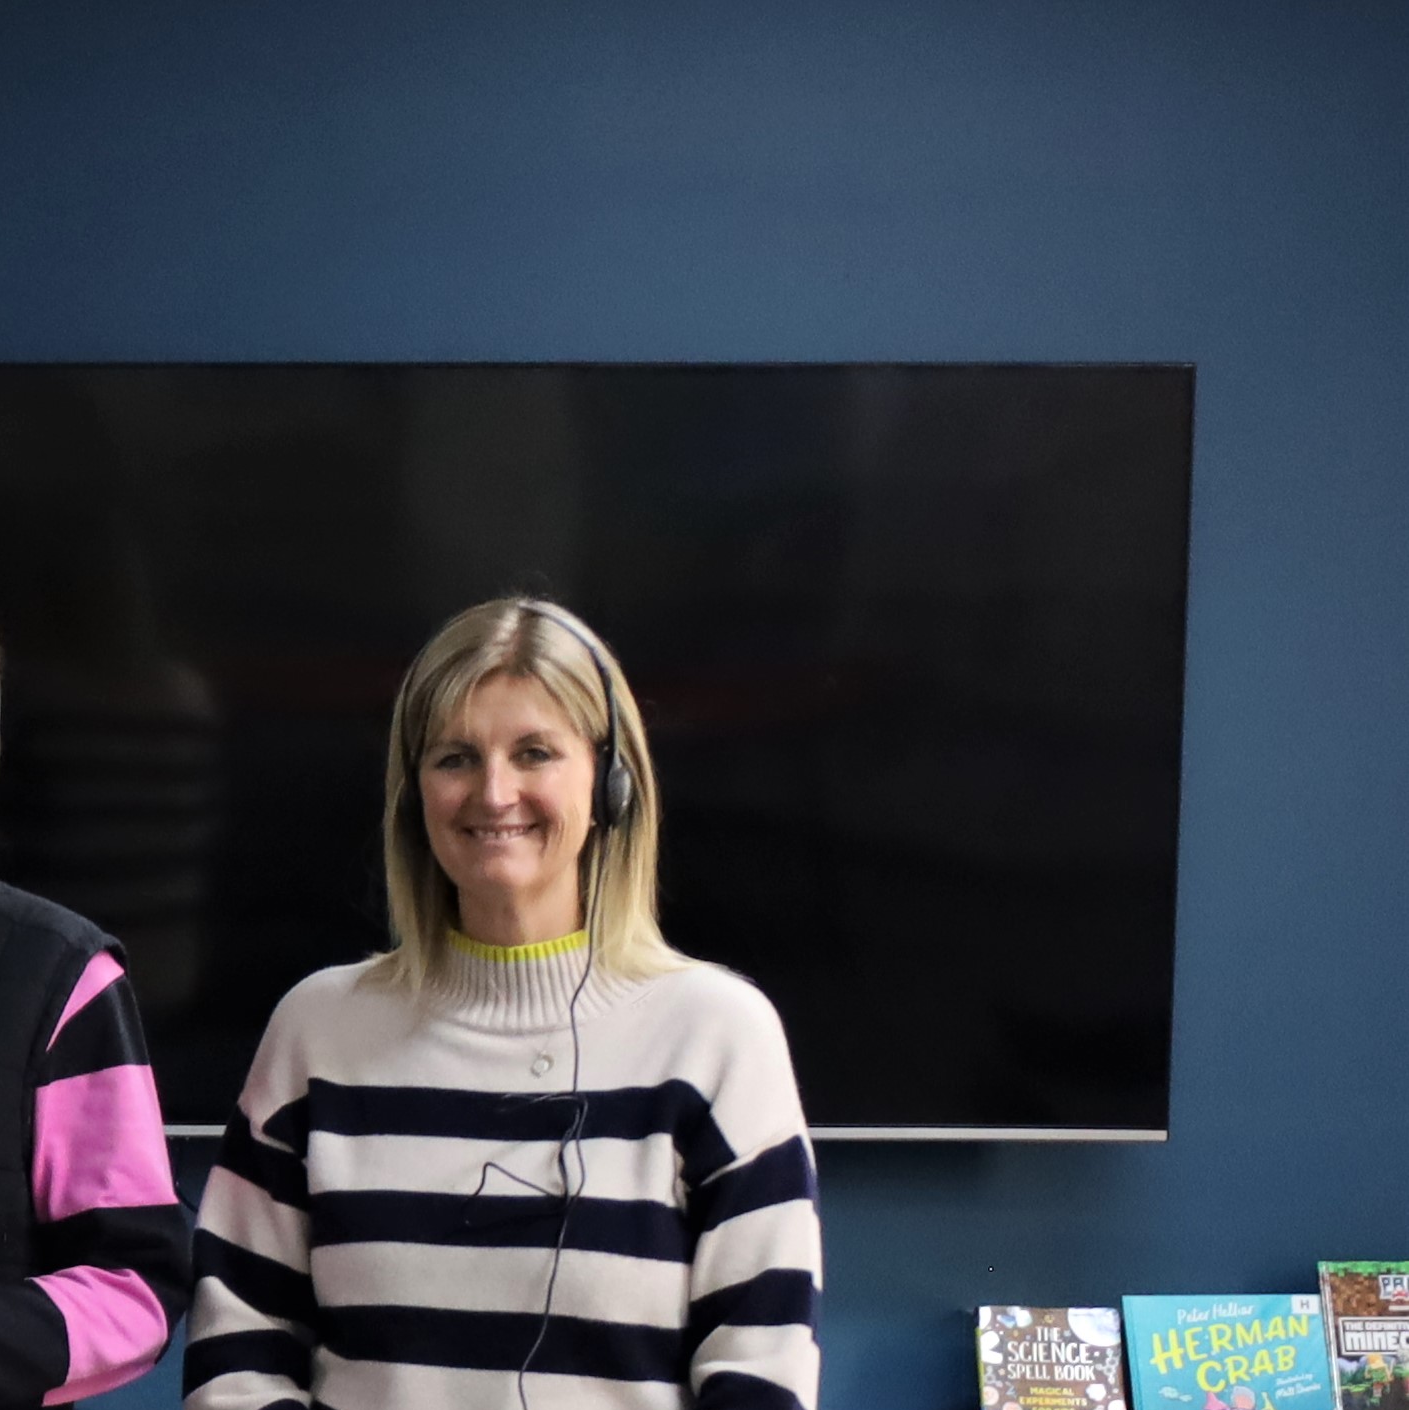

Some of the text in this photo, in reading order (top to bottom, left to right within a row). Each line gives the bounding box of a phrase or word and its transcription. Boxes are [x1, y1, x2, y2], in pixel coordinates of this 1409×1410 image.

[1300, 1300, 1310, 1310] H
[1177, 1308, 1210, 1325] Peter
[1344, 1321, 1363, 1330] THE
[1036, 1326, 1062, 1342] THE
[1007, 1341, 1093, 1364] SCIENCE
[1150, 1315, 1309, 1375] HERMAN
[1007, 1363, 1096, 1381] SPELL BOOK
[1196, 1345, 1296, 1393] CRAB
[1029, 1386, 1074, 1396] MAGICAL
[1019, 1396, 1088, 1406] EXPERIMENTS
